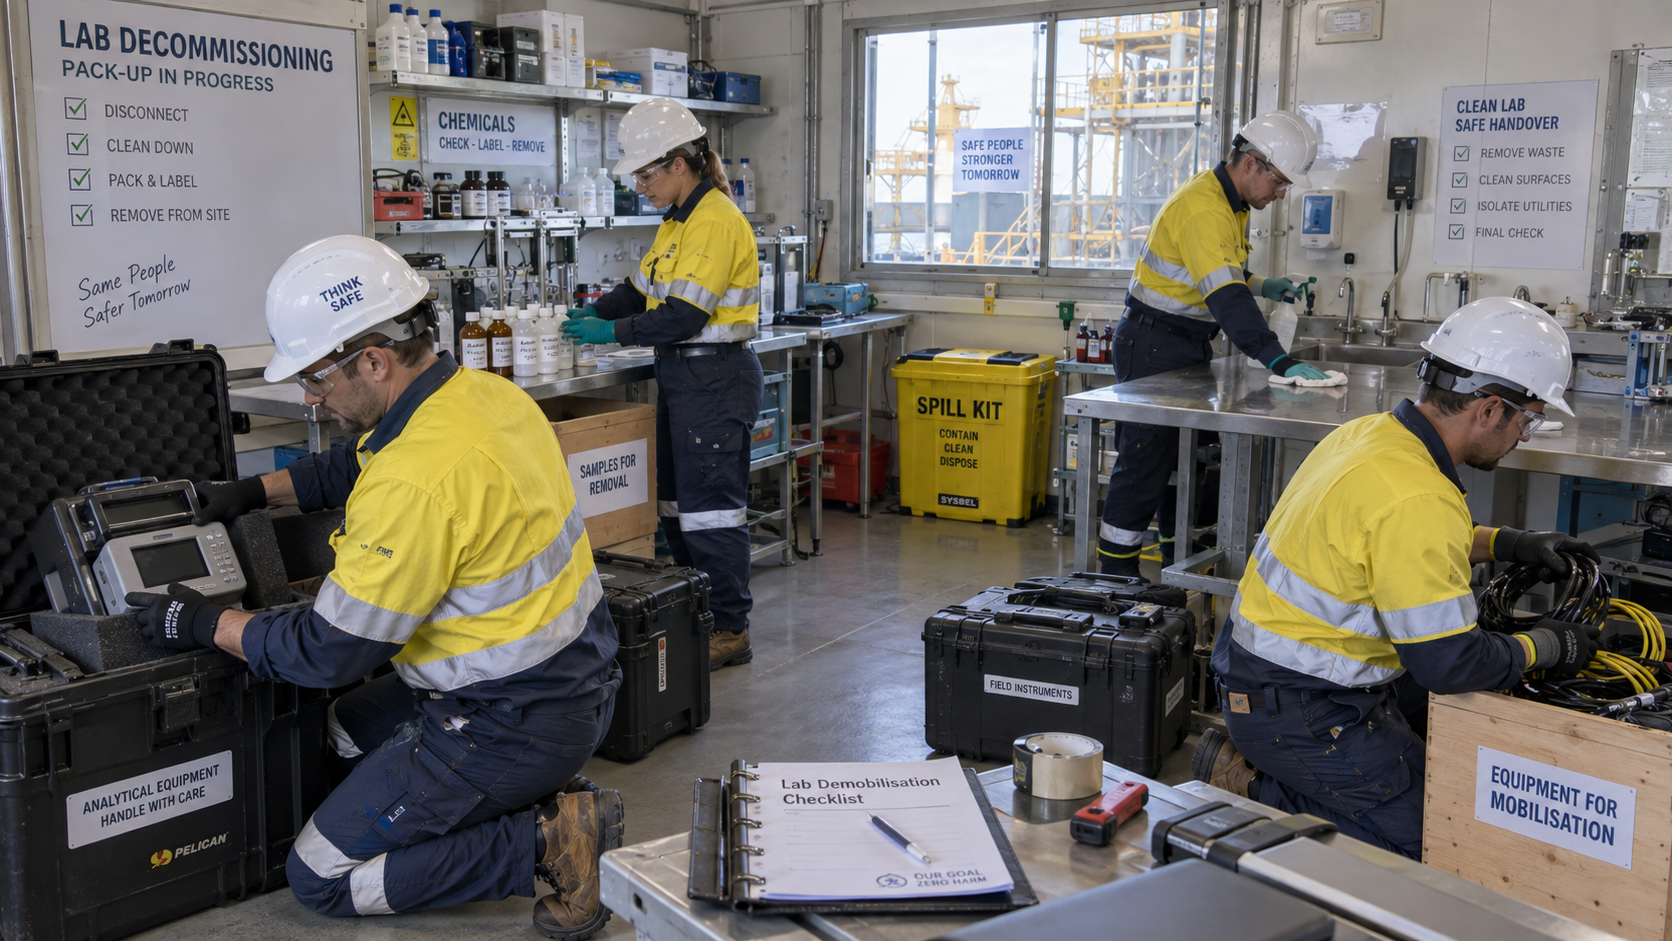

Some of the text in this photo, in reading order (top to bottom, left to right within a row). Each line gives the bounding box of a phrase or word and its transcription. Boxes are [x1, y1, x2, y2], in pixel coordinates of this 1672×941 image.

[59, 20, 110, 51] LAB
[120, 26, 333, 73] DECOMMISSIONING
[62, 59, 274, 92] PACK-UP IN PROGRESS
[104, 104, 188, 122] DISCONNECT
[1457, 98, 1525, 114] CLEAN LAB
[438, 111, 516, 132] CHEMICALS
[1455, 116, 1559, 132] SAFE HANDOVER
[107, 139, 194, 155] CLEAN DOWN
[439, 136, 470, 150] CHECK
[478, 138, 504, 151] LABEL
[512, 140, 545, 152] REMOVE
[962, 139, 1024, 150] SAFE PEOPLE
[962, 154, 1013, 165] STRONGER
[1481, 147, 1565, 158] REMOVE WASTE
[108, 174, 198, 188] PACK & LABEL
[961, 169, 1020, 180] TOMORROW
[1479, 174, 1571, 185] CLEAN SURFACES
[1478, 201, 1572, 212] ISOLATE UTILITIES
[111, 208, 230, 222] REMOVE FROM SITE
[1476, 227, 1544, 238] FINAL CHECK
[78, 254, 176, 301] Same People
[319, 276, 363, 302] THINK
[83, 279, 191, 328] Safer Tomorrow
[330, 290, 364, 312] SAFE
[917, 396, 1003, 420] SPILL KIT
[940, 428, 978, 441] CONTAIN
[944, 443, 974, 454] CLEAN
[580, 453, 636, 479] SAMPLES FOR
[940, 456, 978, 469] DISPOSE
[590, 474, 629, 496] REMOVAL
[941, 496, 976, 508] SYSBEL
[990, 680, 1073, 700] FIELD INSTRUMENTS
[83, 764, 220, 815] ANALYTICAL EQUIPMENT
[782, 776, 940, 790] Lab Demobilisation
[783, 793, 864, 805] Checklist
[1491, 765, 1617, 819] EQUIPMENT FOR
[101, 786, 206, 828] HANDLE WITH CARE
[1490, 790, 1615, 846] MOBILISATION
[174, 833, 227, 859] PELICAN
[914, 869, 983, 880] OUR GOAL
[916, 876, 987, 887] ZERO HARM
